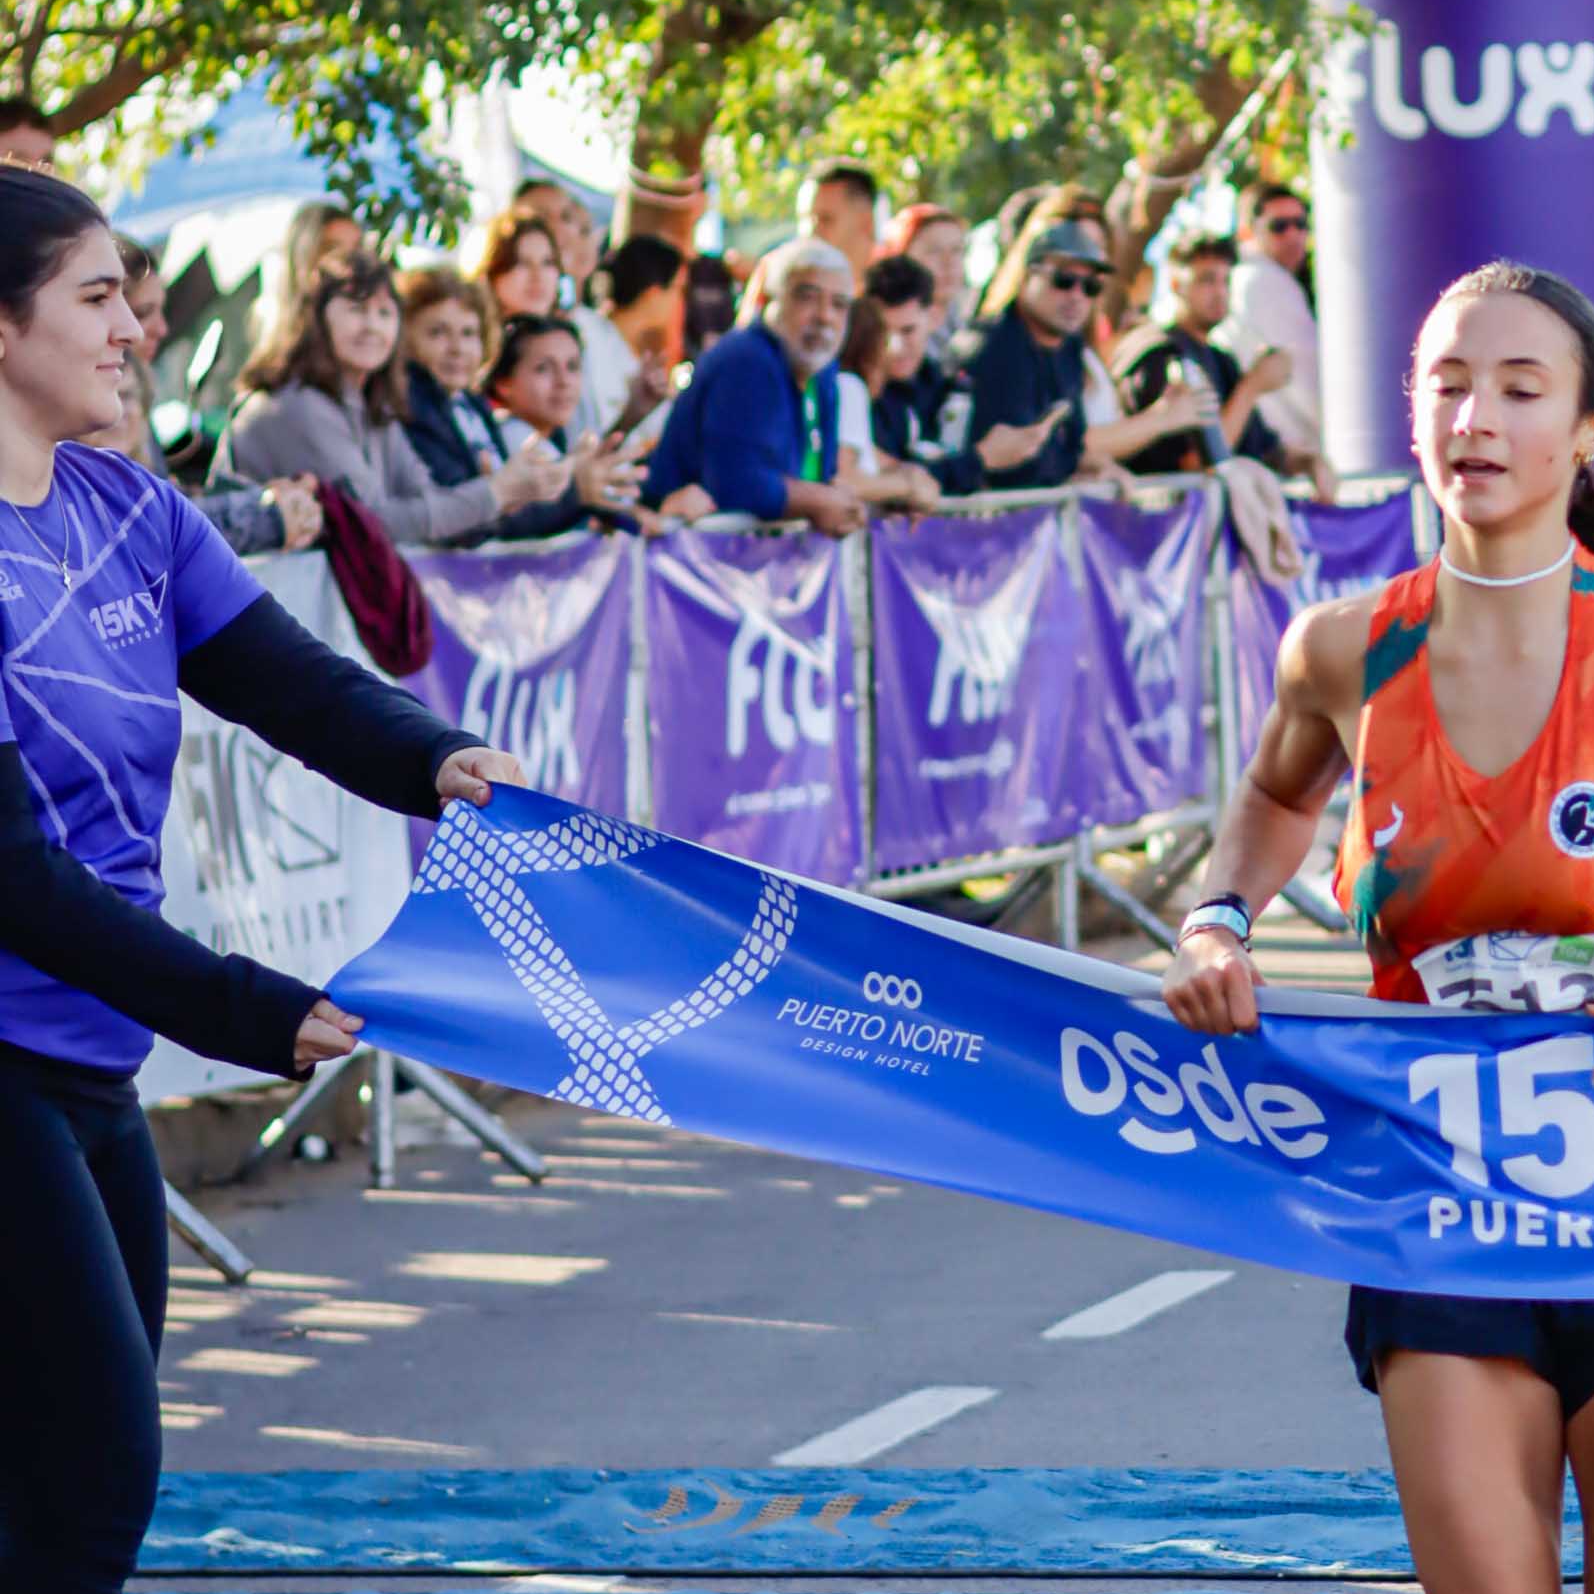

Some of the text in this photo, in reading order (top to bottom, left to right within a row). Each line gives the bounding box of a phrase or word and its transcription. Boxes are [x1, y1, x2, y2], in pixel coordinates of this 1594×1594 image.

[89, 595, 147, 640] 15K
[776, 998, 985, 1065] PUERTO NORTE
[800, 1037, 931, 1077] DESIGN HOTEL
